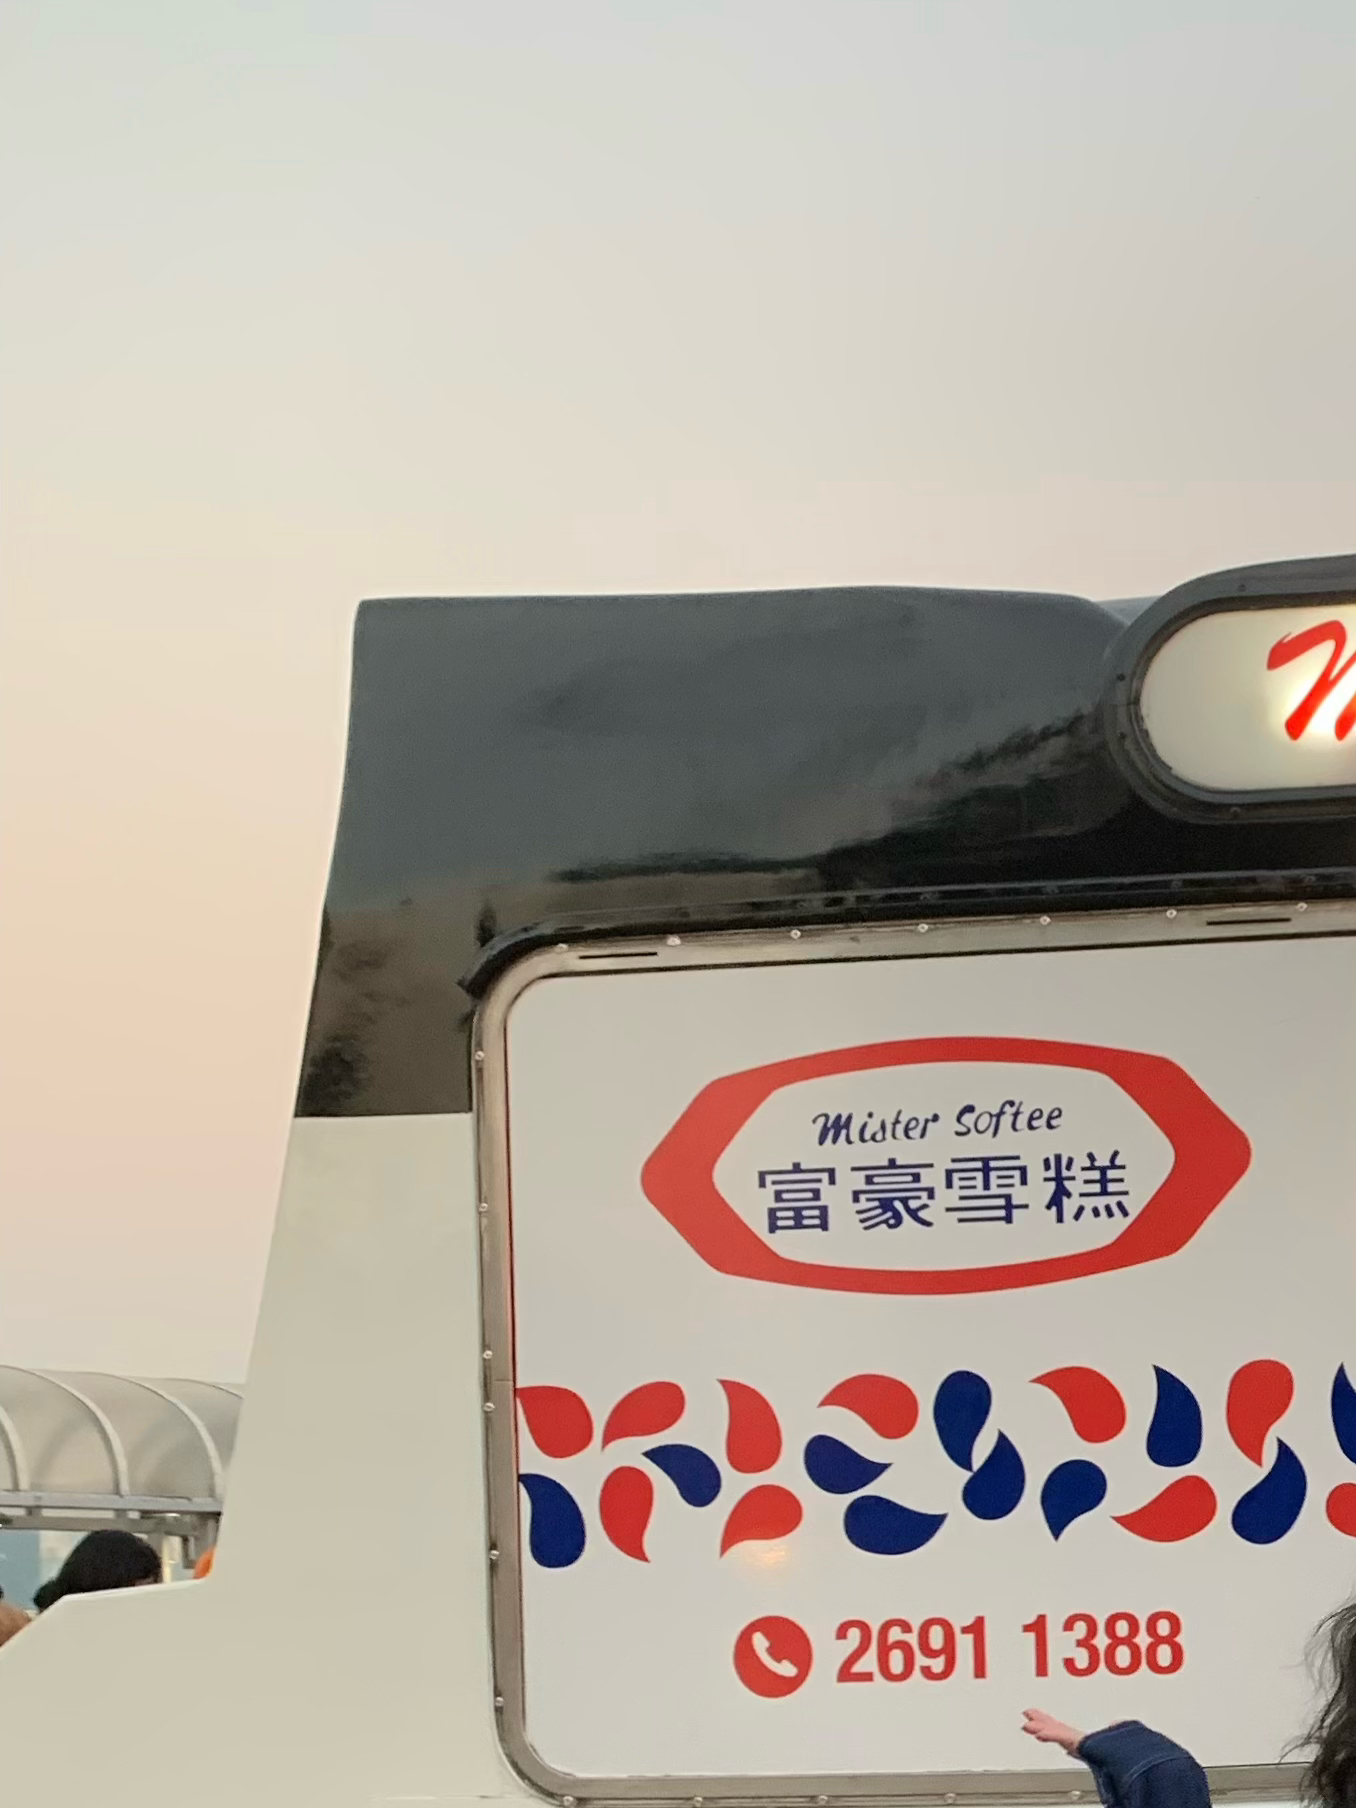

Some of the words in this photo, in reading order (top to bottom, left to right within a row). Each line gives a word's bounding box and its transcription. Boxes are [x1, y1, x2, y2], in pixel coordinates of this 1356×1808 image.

[811, 1109, 940, 1147] Mister
[953, 1099, 1063, 1140] Softee
[757, 1150, 1131, 1235] 富豪雪糕
[835, 1615, 988, 1683] 2691
[1023, 1609, 1186, 1679] 1388
